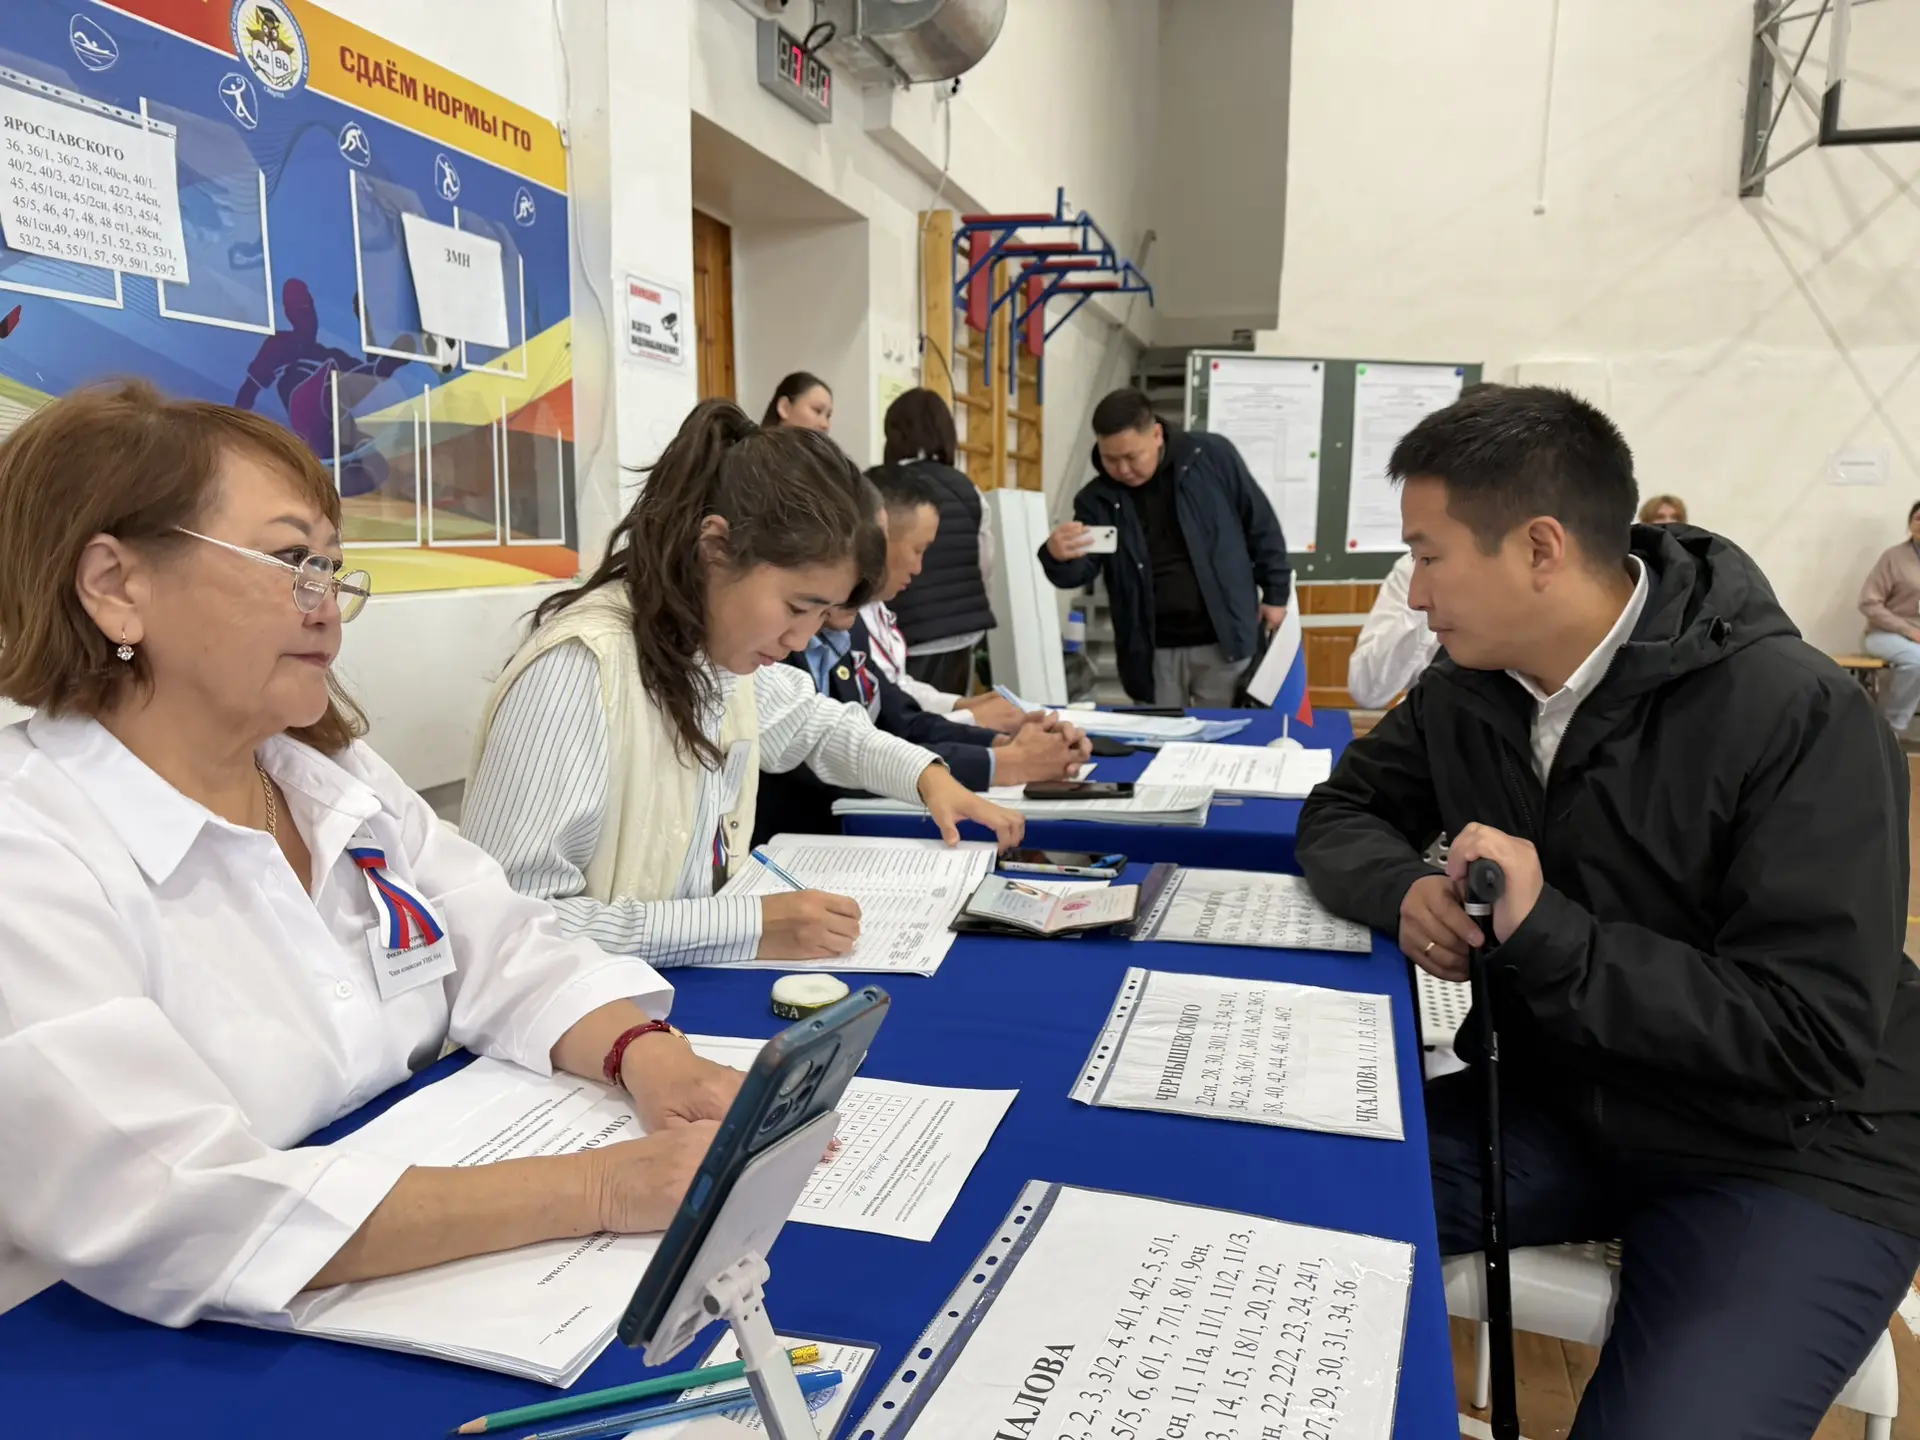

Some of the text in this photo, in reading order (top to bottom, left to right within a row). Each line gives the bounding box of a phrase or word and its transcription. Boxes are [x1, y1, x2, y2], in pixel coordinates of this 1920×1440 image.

[256, 49, 269, 64] Aa
[275, 57, 288, 71] Bb
[340, 46, 532, 152] СДАЁМ НОРМЫ ГТО
[4, 116, 124, 160] ЯРОСЛАВСКОГО
[1155, 1005, 1201, 1100] ЧЕРНЫШЕВСКОГО
[1208, 1034, 1228, 1051] 30/1,
[1204, 1054, 1224, 1065] 30,
[1236, 1053, 1259, 1072] 36/1,
[1269, 1057, 1287, 1068] 44,
[1201, 1068, 1222, 1080] 28,
[1233, 1074, 1255, 1087] 36,
[1268, 1071, 1286, 1083] 42,
[1194, 1084, 1221, 1107] 22сн,
[1228, 1090, 1253, 1110] 34/2,
[1265, 1086, 1288, 1098] 40,
[1356, 1066, 1378, 1122] ЧКАЛОВА
[1262, 1102, 1284, 1116] 38,
[1149, 1234, 1179, 1257] 5/1,
[1223, 1230, 1256, 1263] 11/3,
[1142, 1262, 1168, 1272] 5,
[1181, 1244, 1214, 1270] 9сн,
[1129, 1277, 1161, 1300] 4/2,
[1169, 1276, 1202, 1298] 8/1,
[1210, 1270, 1244, 1299] 11/2,
[1252, 1264, 1286, 1295] 21/2,
[1333, 1280, 1357, 1299] 36
[1115, 1306, 1148, 1330] 4/1,
[1157, 1304, 1191, 1327] 7/1,
[1244, 1300, 1275, 1320] 20,
[1328, 1304, 1358, 1323] 34,
[1196, 1306, 1232, 1338] 11/1,
[1108, 1336, 1135, 1348] 4,
[1149, 1335, 1179, 1344] 7,
[1232, 1326, 1268, 1360] 18/1,
[1261, 1258, 1326, 1440] н, 22, 22/2, 23, 24, 24/1,
[1322, 1329, 1353, 1350] 31,
[1089, 1355, 1127, 1383] 3/2,
[1136, 1353, 1172, 1380] 6/1,
[1182, 1346, 1218, 1374] 11а,
[1316, 1356, 1348, 1380] 30,
[1223, 1368, 1256, 1388] 15,
[1079, 1389, 1111, 1403] 3,
[1128, 1387, 1158, 1400] 6,
[1171, 1383, 1206, 1404] 11,
[1310, 1386, 1343, 1409] 29,
[1069, 1410, 1102, 1425] 2,
[1213, 1396, 1248, 1419] 14,
